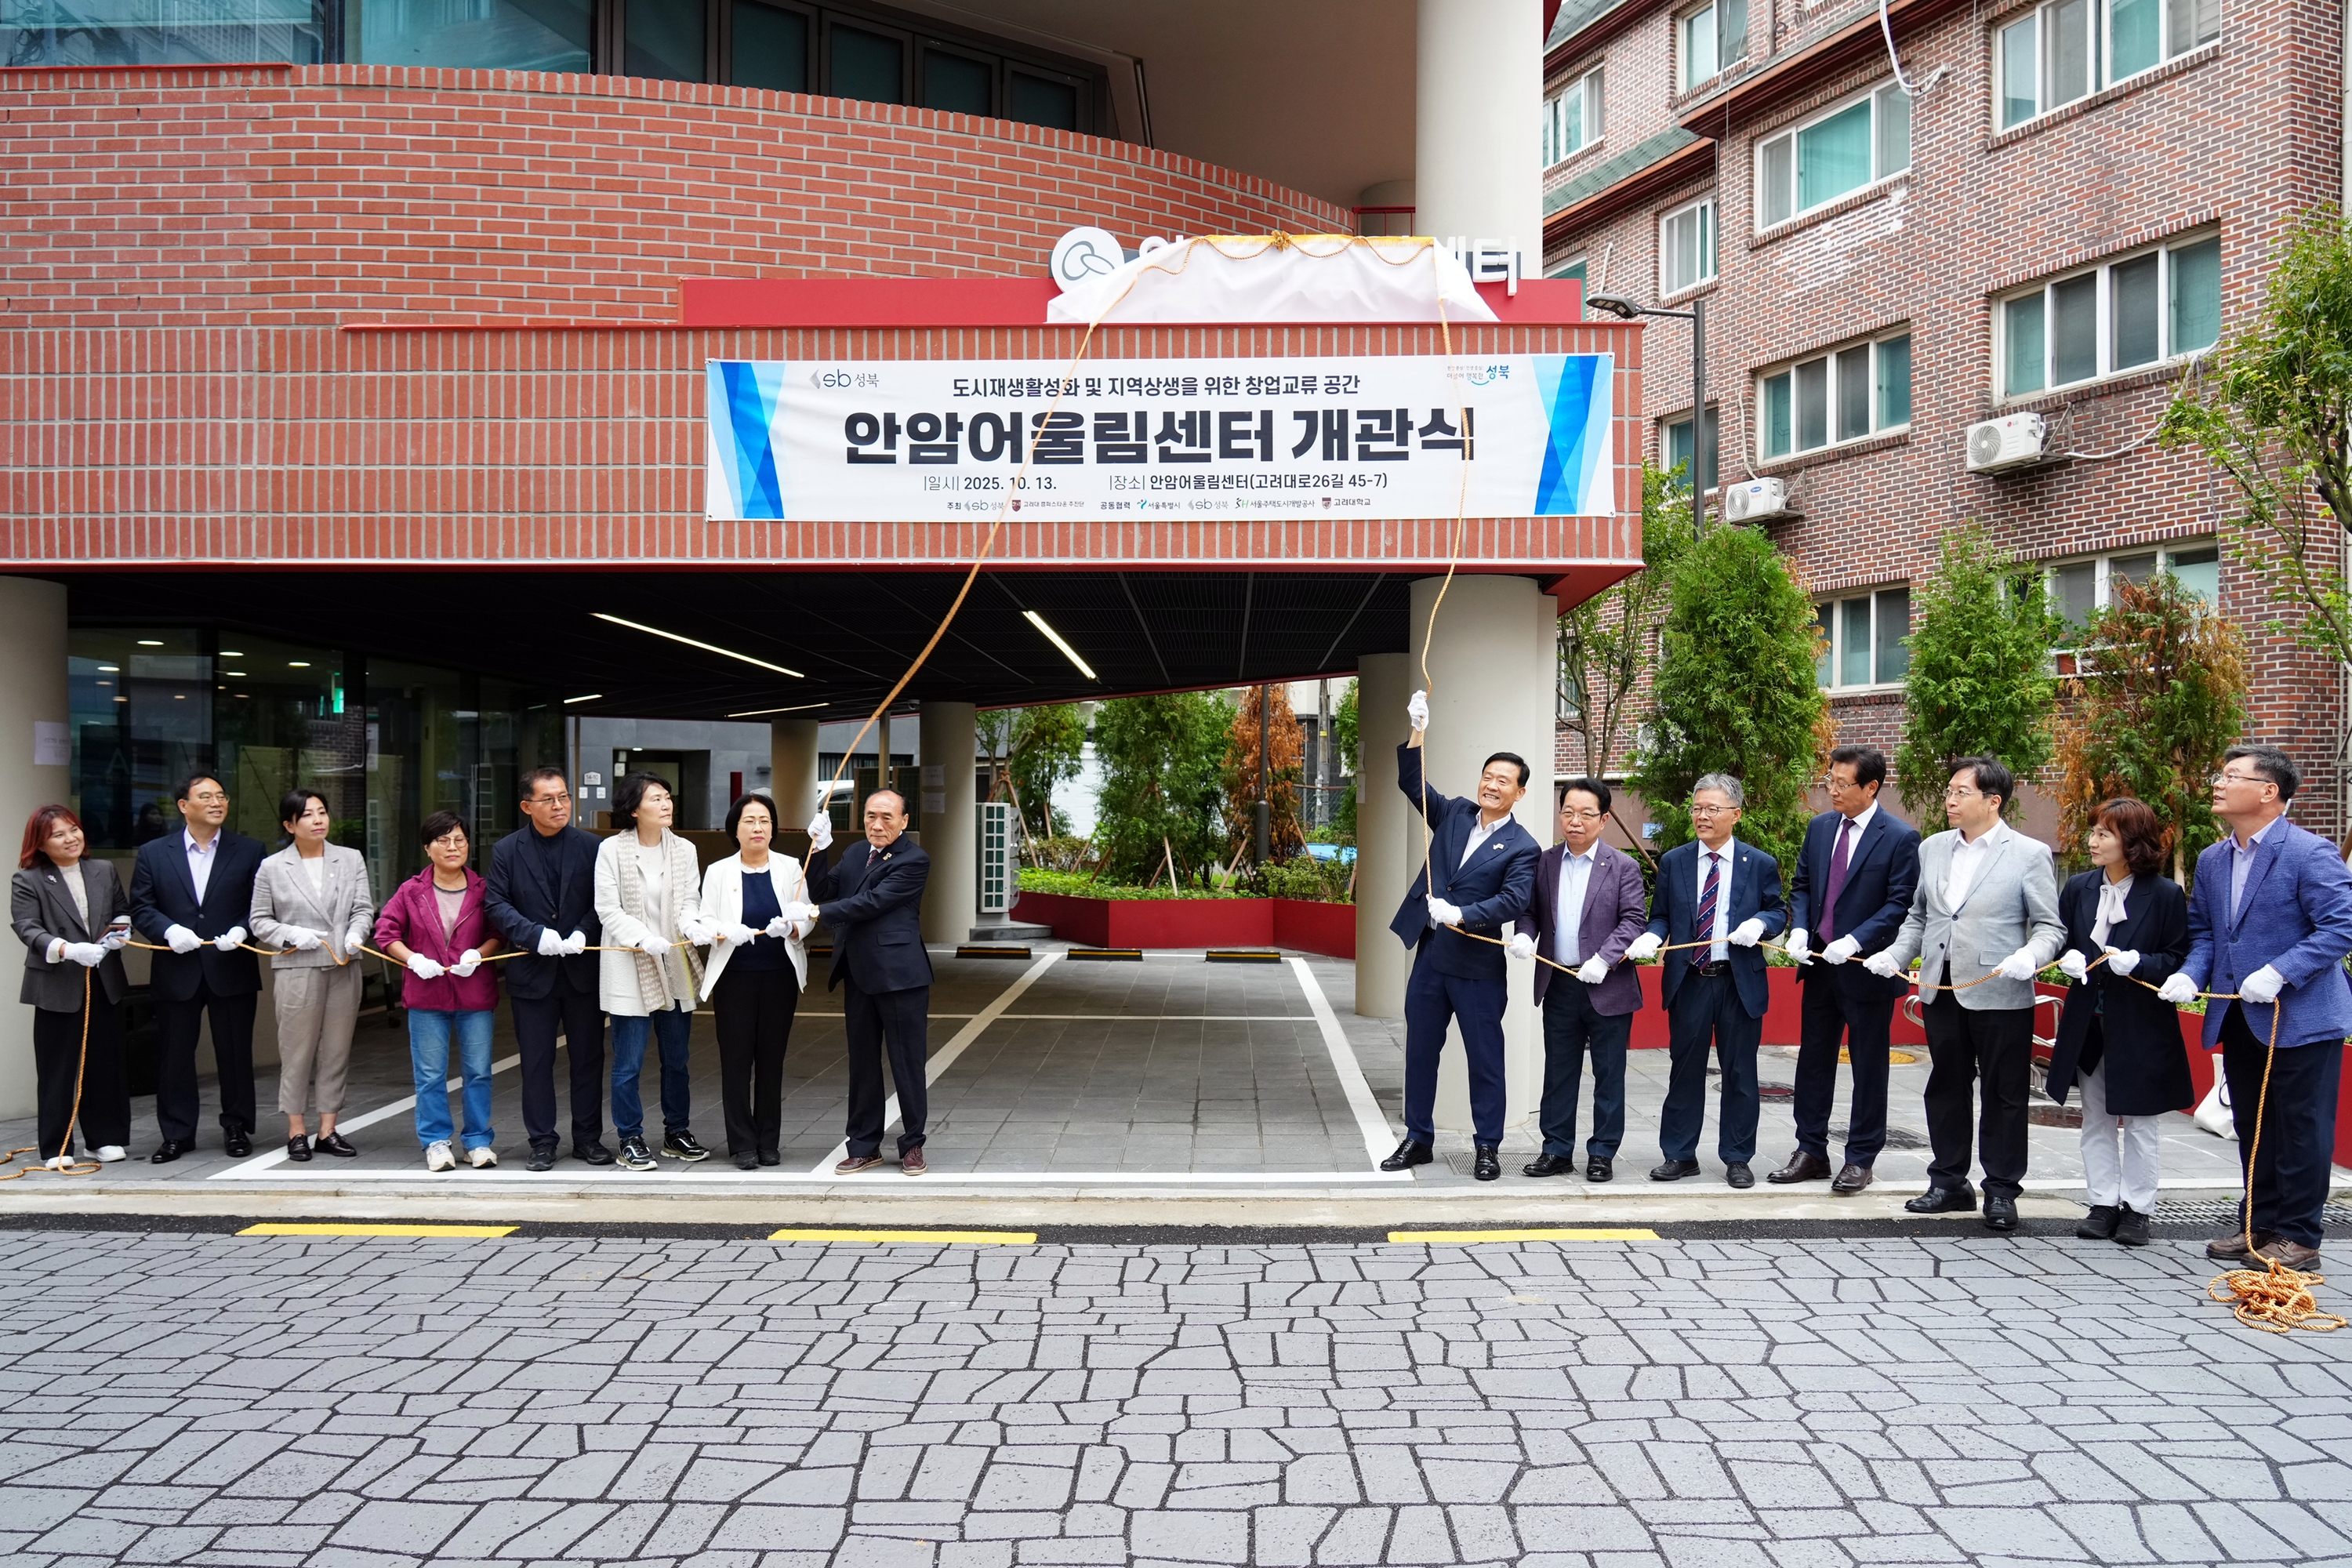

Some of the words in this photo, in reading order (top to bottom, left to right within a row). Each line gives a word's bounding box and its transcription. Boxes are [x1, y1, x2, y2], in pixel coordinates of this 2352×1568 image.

[822, 368, 851, 387] sb
[854, 372, 880, 388] 성북
[1466, 372, 1483, 381] 행복한
[1486, 365, 1510, 379] 성북
[953, 377, 1080, 397] 도시재생활성화
[1085, 377, 1102, 397] 및
[1108, 376, 1199, 397] 지역상생을
[1204, 376, 1241, 396] 위한
[1245, 376, 1318, 396] 창업교류
[1323, 375, 1361, 395] 공간
[845, 410, 1274, 464] 안암어울림센터
[1291, 407, 1475, 462] 개관식
[964, 477, 1004, 490] 2025.
[1009, 477, 1030, 490] 10.
[1036, 477, 1057, 490] 13.
[1150, 474, 1344, 490] 안암어울림센터(고려대로26길
[1348, 472, 1388, 488] 45-7)
[947, 502, 962, 510] 주최
[971, 499, 989, 511] sb
[990, 502, 1004, 510] 성북
[1100, 501, 1131, 510] 공동협력
[1147, 501, 1181, 510] 서울특별시
[1195, 498, 1213, 510] sb
[1213, 500, 1229, 510] 성북
[1250, 499, 1316, 509] 서울주택도시개발공사
[1334, 498, 1371, 506] 고려대학교
